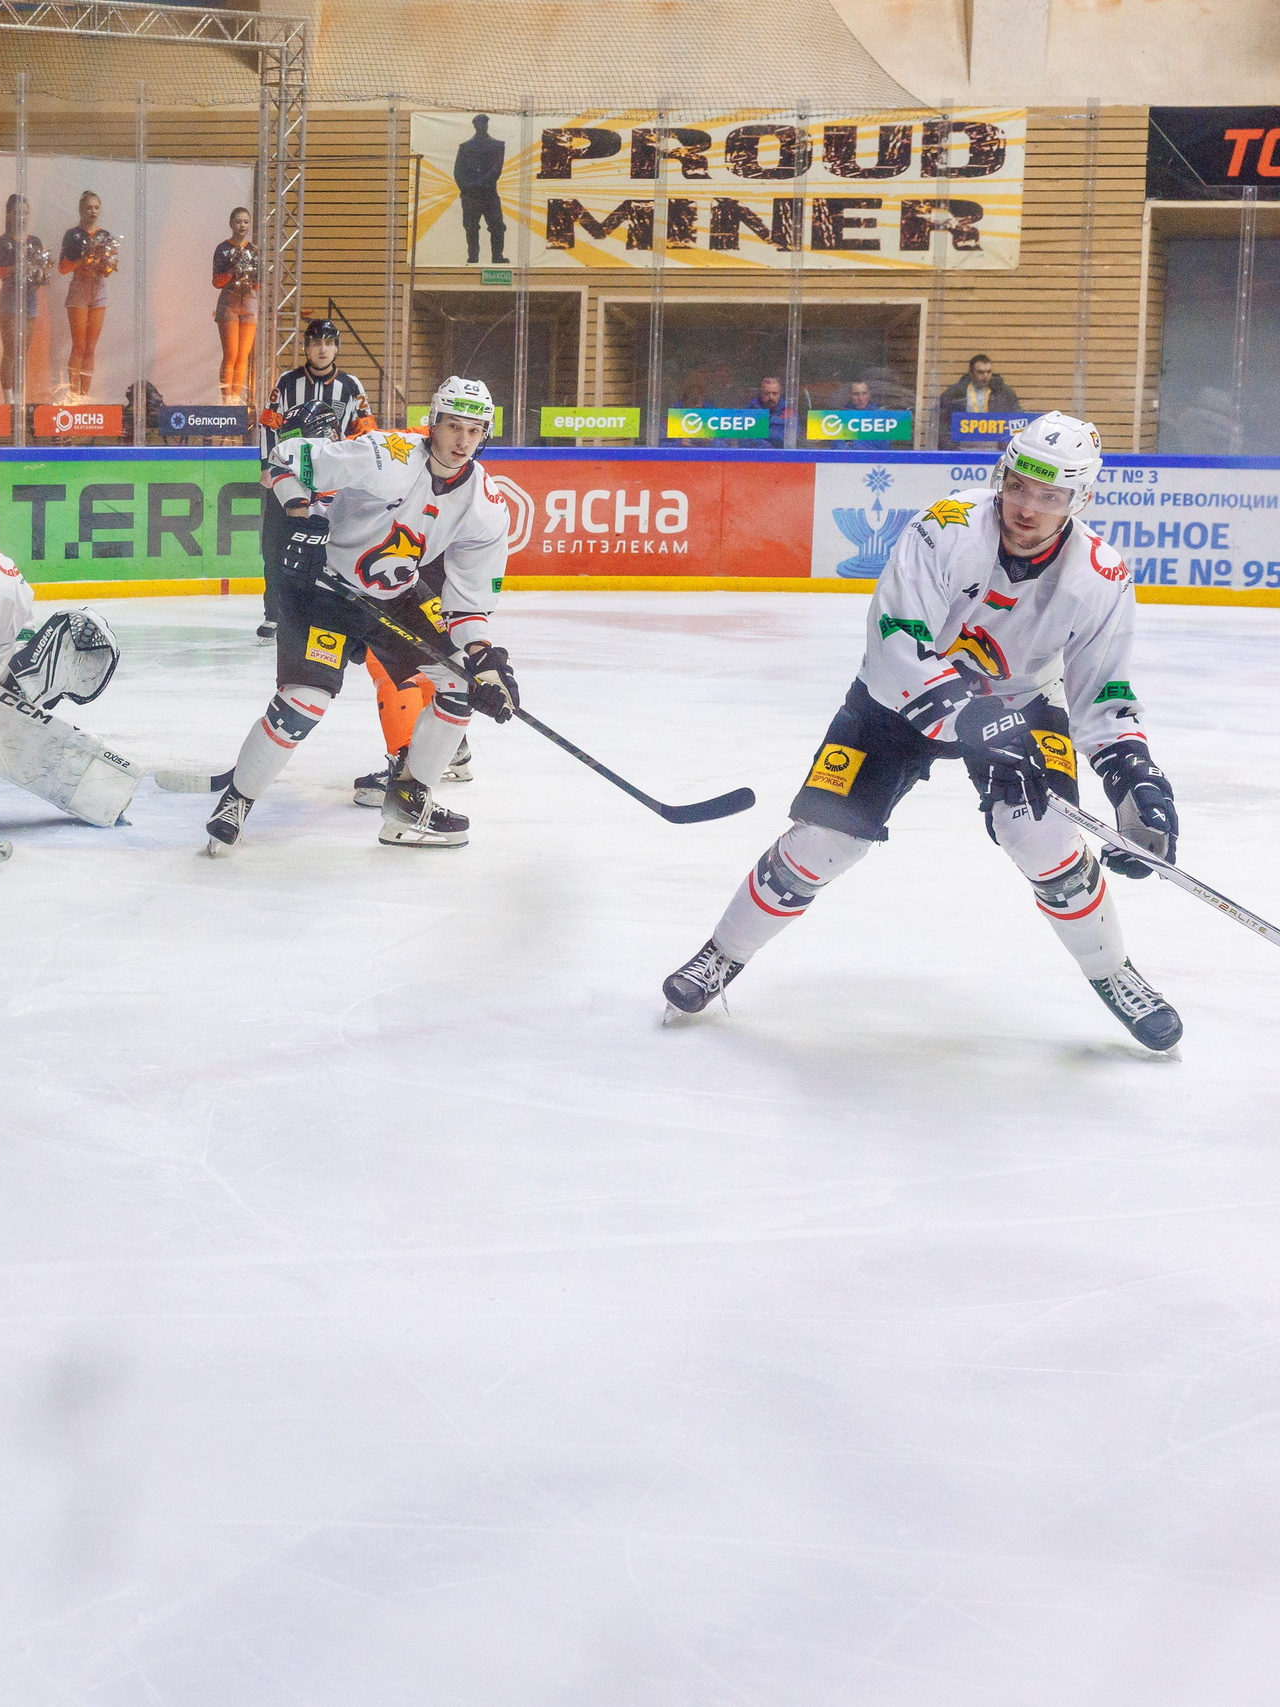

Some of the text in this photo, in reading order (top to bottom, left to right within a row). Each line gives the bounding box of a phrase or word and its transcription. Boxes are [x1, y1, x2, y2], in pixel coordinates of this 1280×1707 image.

[536, 124, 1007, 180] PROUD
[545, 198, 984, 253] MINER
[188, 414, 237, 429] белкарт
[554, 415, 627, 431] евроопт
[707, 416, 756, 431] СБЕР
[847, 418, 898, 433] СБЕР
[1045, 431, 1060, 446] 4
[950, 467, 987, 481] ОАО
[1122, 469, 1143, 483] №
[1148, 470, 1159, 484] 3
[543, 489, 689, 534] ЯСНА
[1161, 493, 1278, 511] РЕВОЛЮЦИИ
[1087, 520, 1230, 550] ЕЛЬНОЕ
[543, 540, 688, 554] БЕЛТЭЛЕКАМ
[1189, 559, 1233, 586] №
[378, 616, 414, 641] SUPER
[30, 626, 54, 664] VAUGHN
[0, 692, 54, 725] CCM
[1068, 812, 1099, 832] BAUER
[1193, 886, 1268, 935] HYP2RLITE
